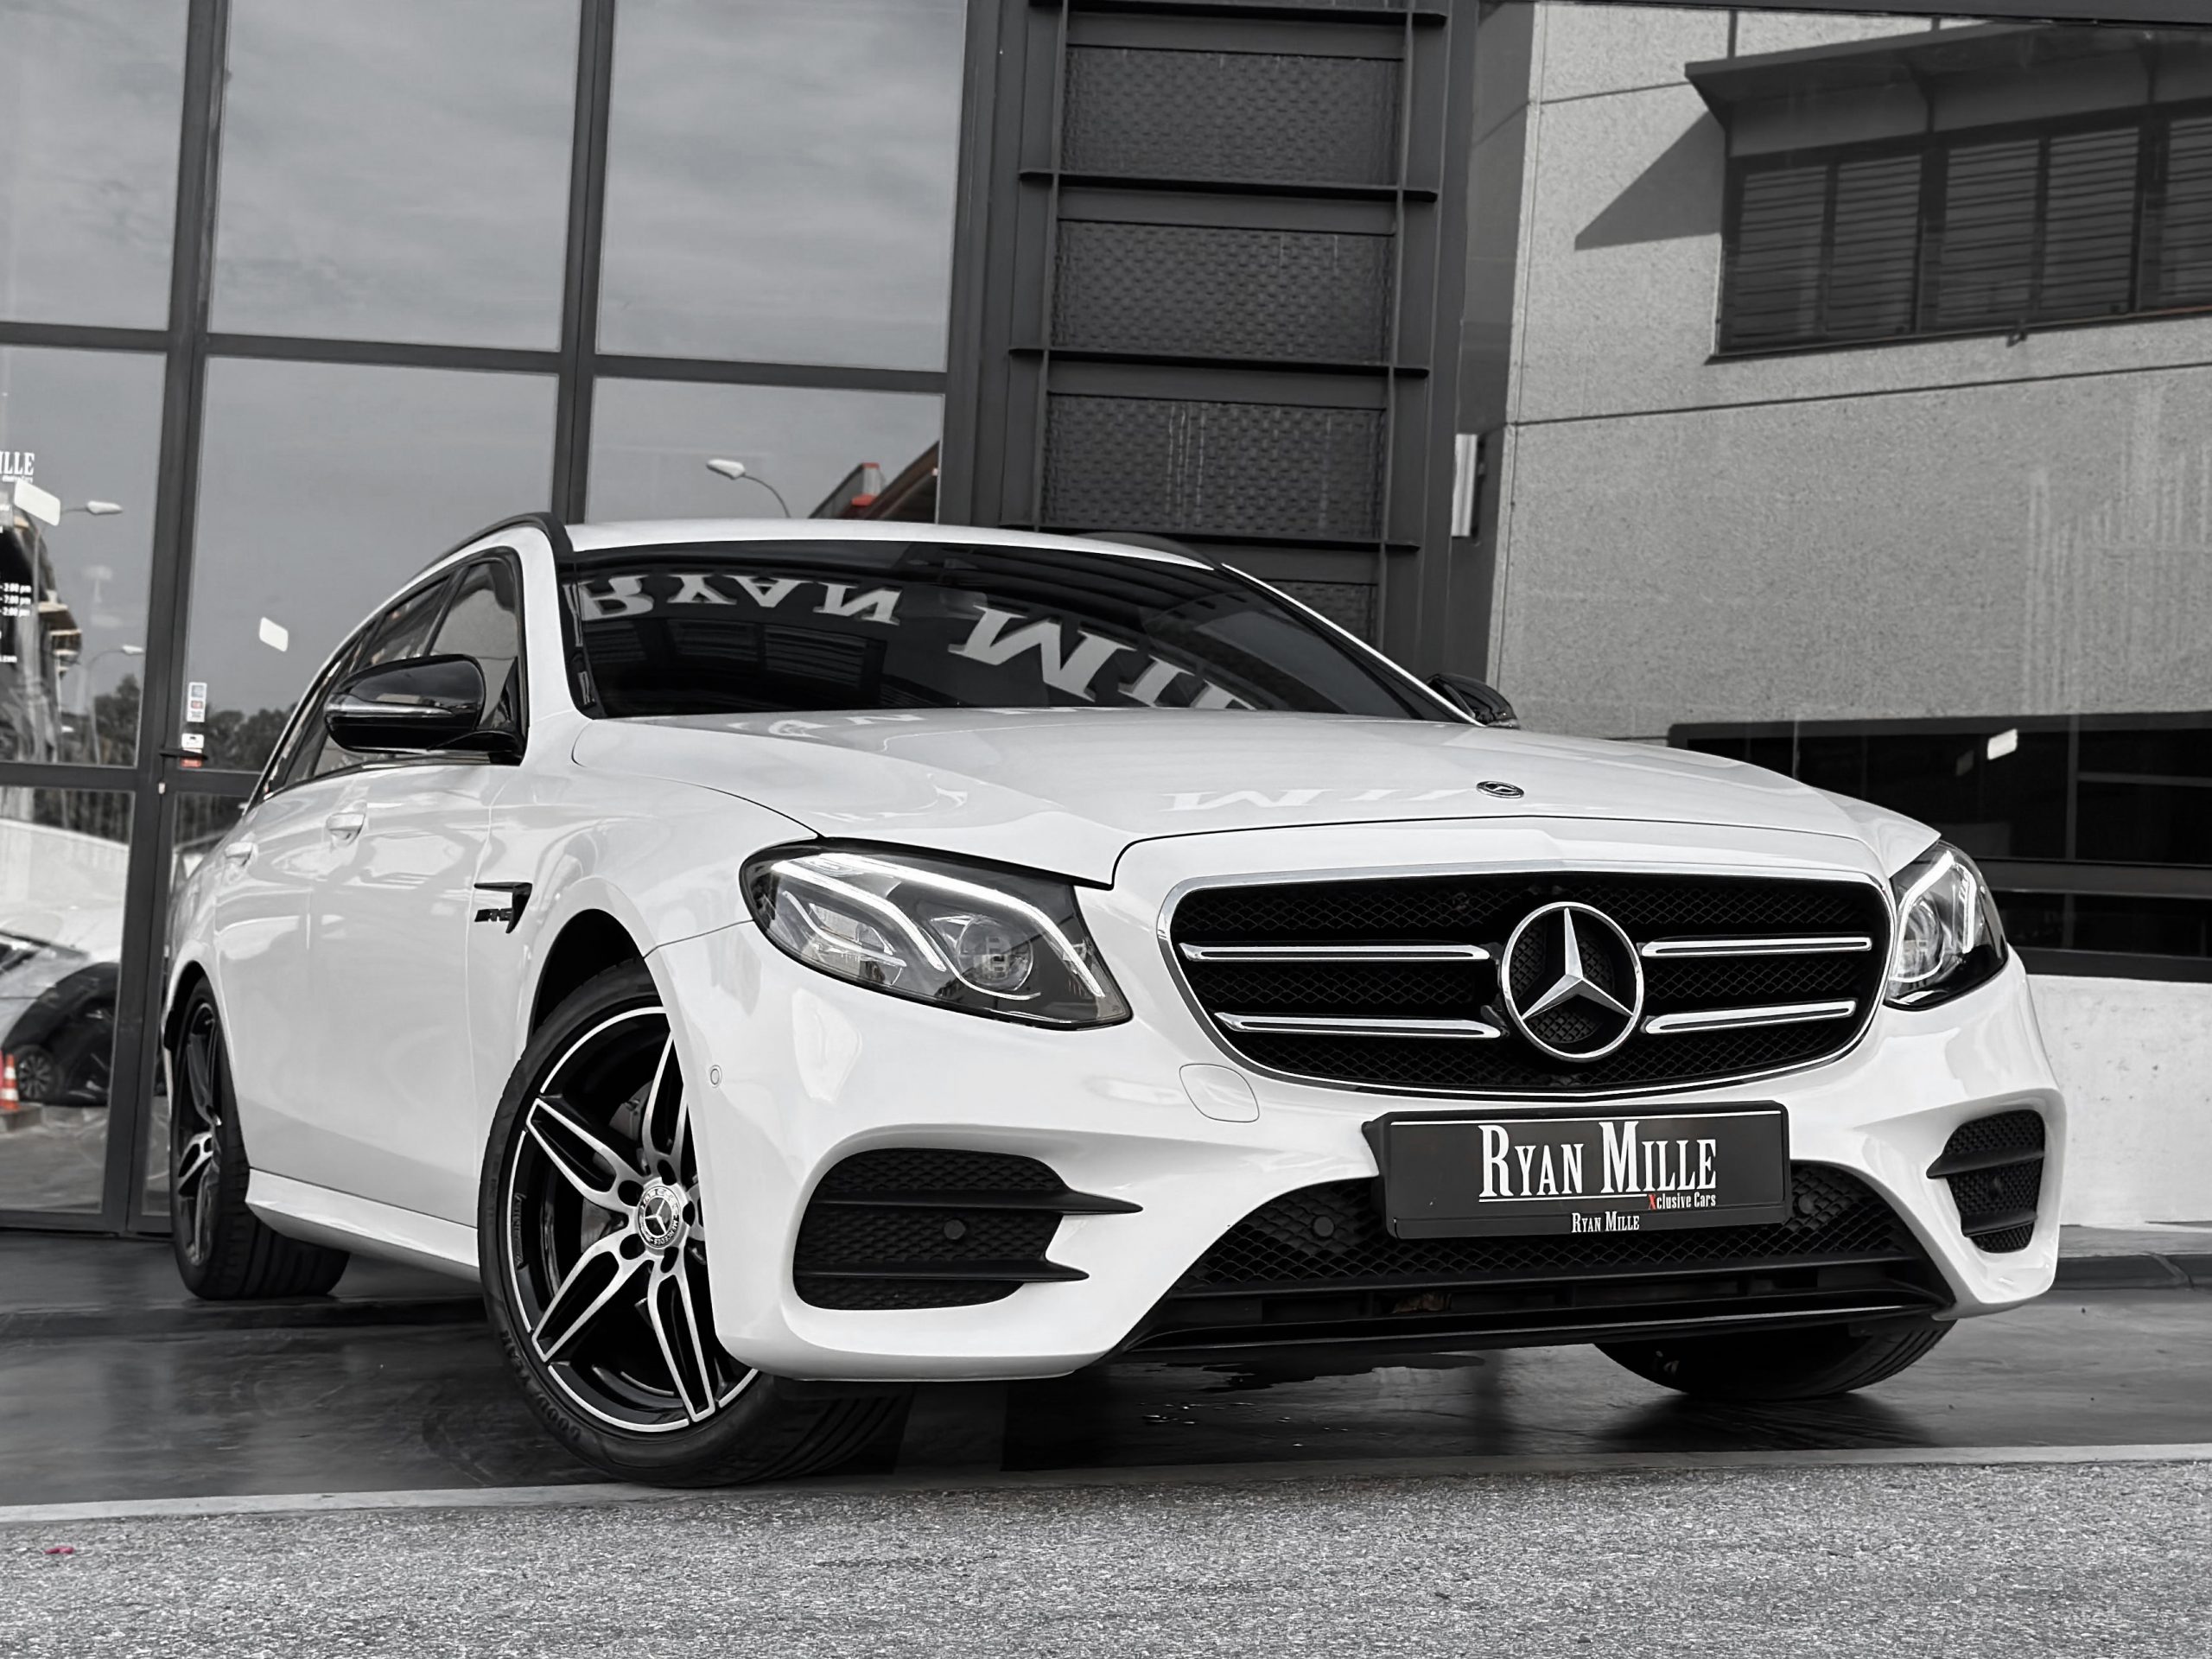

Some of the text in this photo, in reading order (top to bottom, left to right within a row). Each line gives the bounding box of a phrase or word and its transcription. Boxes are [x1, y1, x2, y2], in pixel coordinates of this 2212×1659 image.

[1478, 1121, 1716, 1198] RYAN MILLE
[1649, 1192, 1716, 1211] Xclusive Cars
[1572, 1211, 1640, 1233] RYAN MILLE
